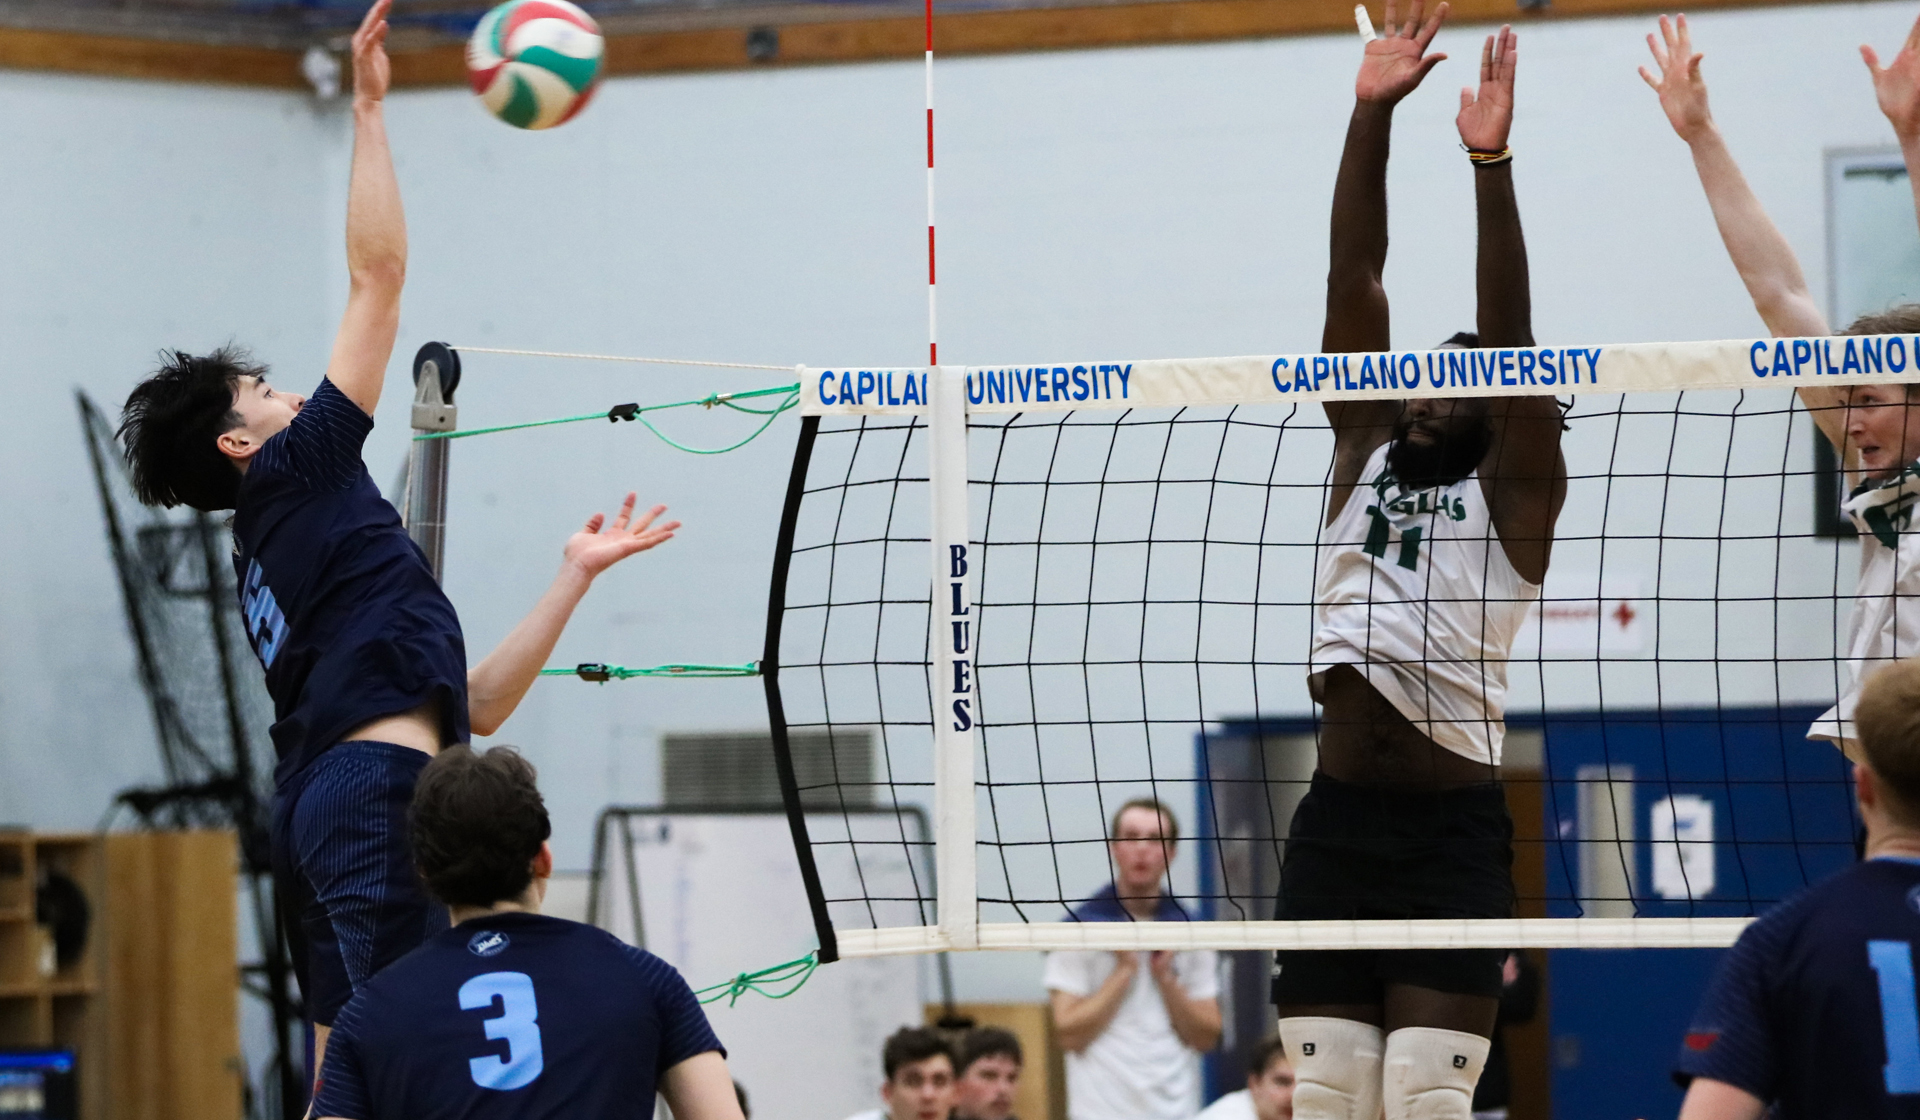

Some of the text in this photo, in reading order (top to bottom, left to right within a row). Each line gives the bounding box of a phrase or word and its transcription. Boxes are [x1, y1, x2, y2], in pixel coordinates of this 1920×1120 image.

[818, 364, 1133, 406] CAPILA UNIVERSITY
[1271, 348, 1603, 393] CAPILANO UNIVERSITY
[1750, 336, 1907, 378] CAPILANO
[1362, 505, 1422, 572] 11
[949, 544, 972, 733] BLUES
[458, 971, 544, 1091] 3
